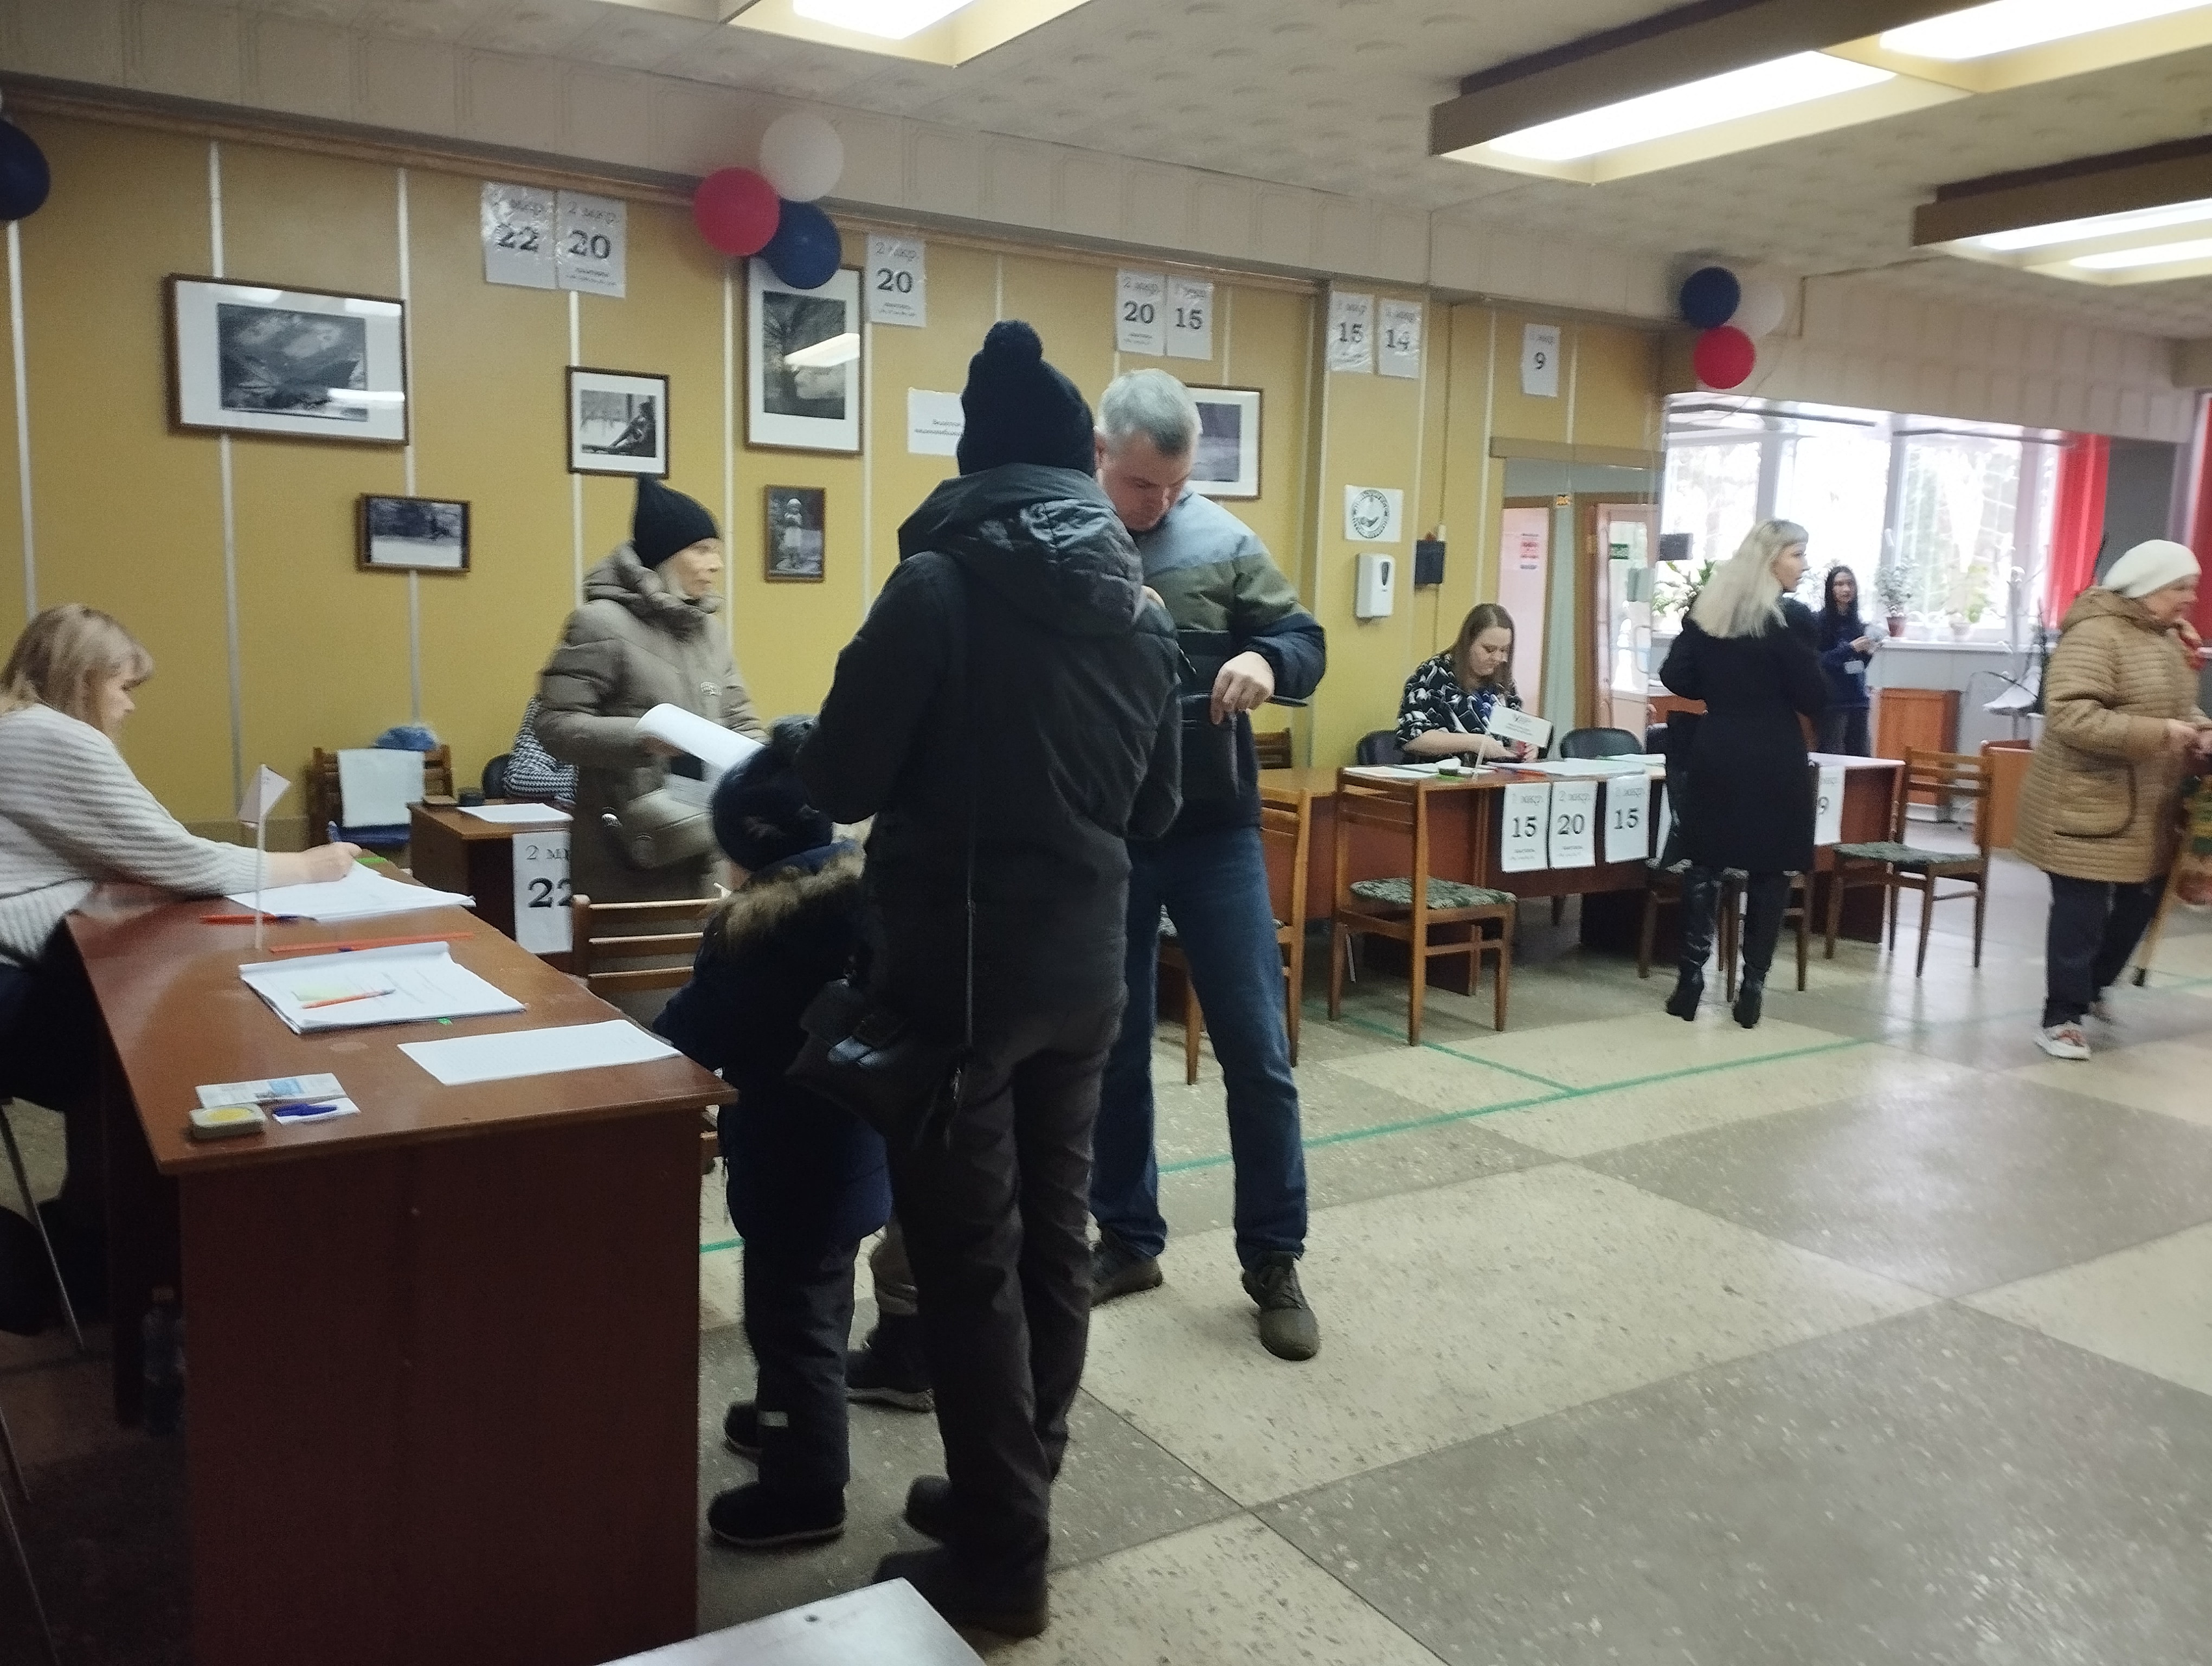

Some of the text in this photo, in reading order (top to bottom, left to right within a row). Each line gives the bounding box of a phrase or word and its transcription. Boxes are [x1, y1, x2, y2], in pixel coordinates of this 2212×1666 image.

[494, 222, 538, 252] 22
[569, 229, 610, 259] 20
[877, 267, 913, 293] 20
[1123, 300, 1155, 324] 20
[1175, 307, 1203, 329] 15
[1339, 322, 1364, 343] 15
[1385, 329, 1410, 351] 14
[1535, 351, 1545, 370] 9
[1559, 790, 1566, 801] 2
[1512, 816, 1537, 837] 15
[1558, 813, 1585, 835] 20
[1614, 808, 1639, 830] 15
[525, 845, 539, 860] 2
